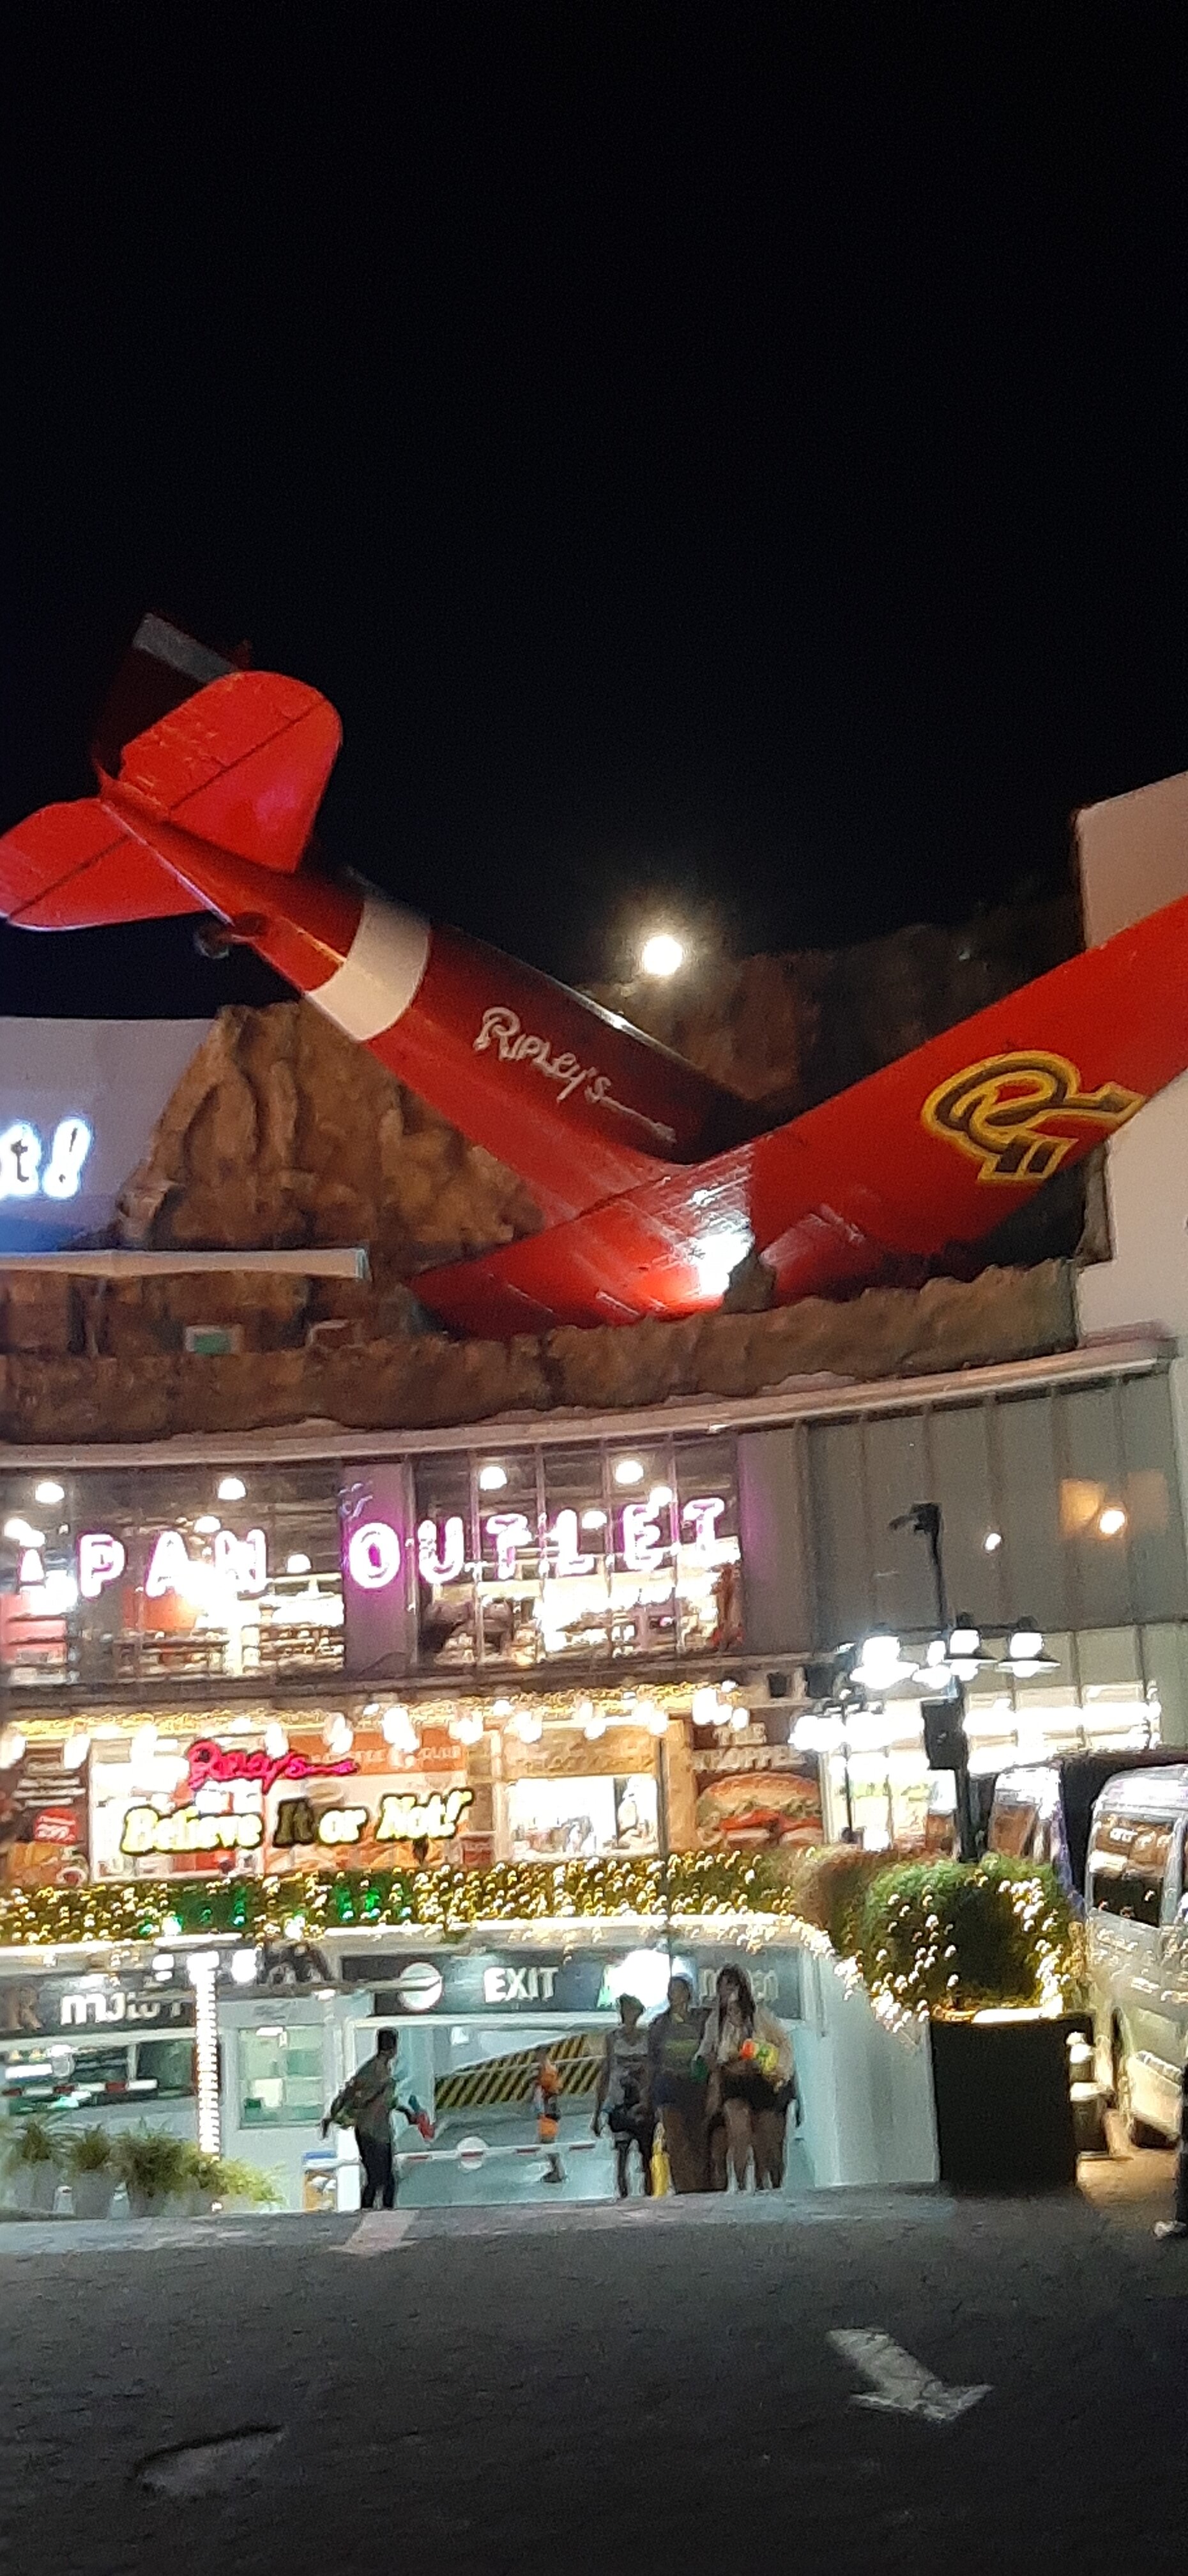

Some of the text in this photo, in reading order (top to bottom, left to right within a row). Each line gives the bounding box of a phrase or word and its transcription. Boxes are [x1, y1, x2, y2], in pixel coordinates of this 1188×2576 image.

[0, 1118, 92, 1199] t!
[347, 1496, 726, 1588] OUTLET
[120, 1788, 474, 1855] Believe It or Not!
[484, 1966, 560, 2004] EXIT
